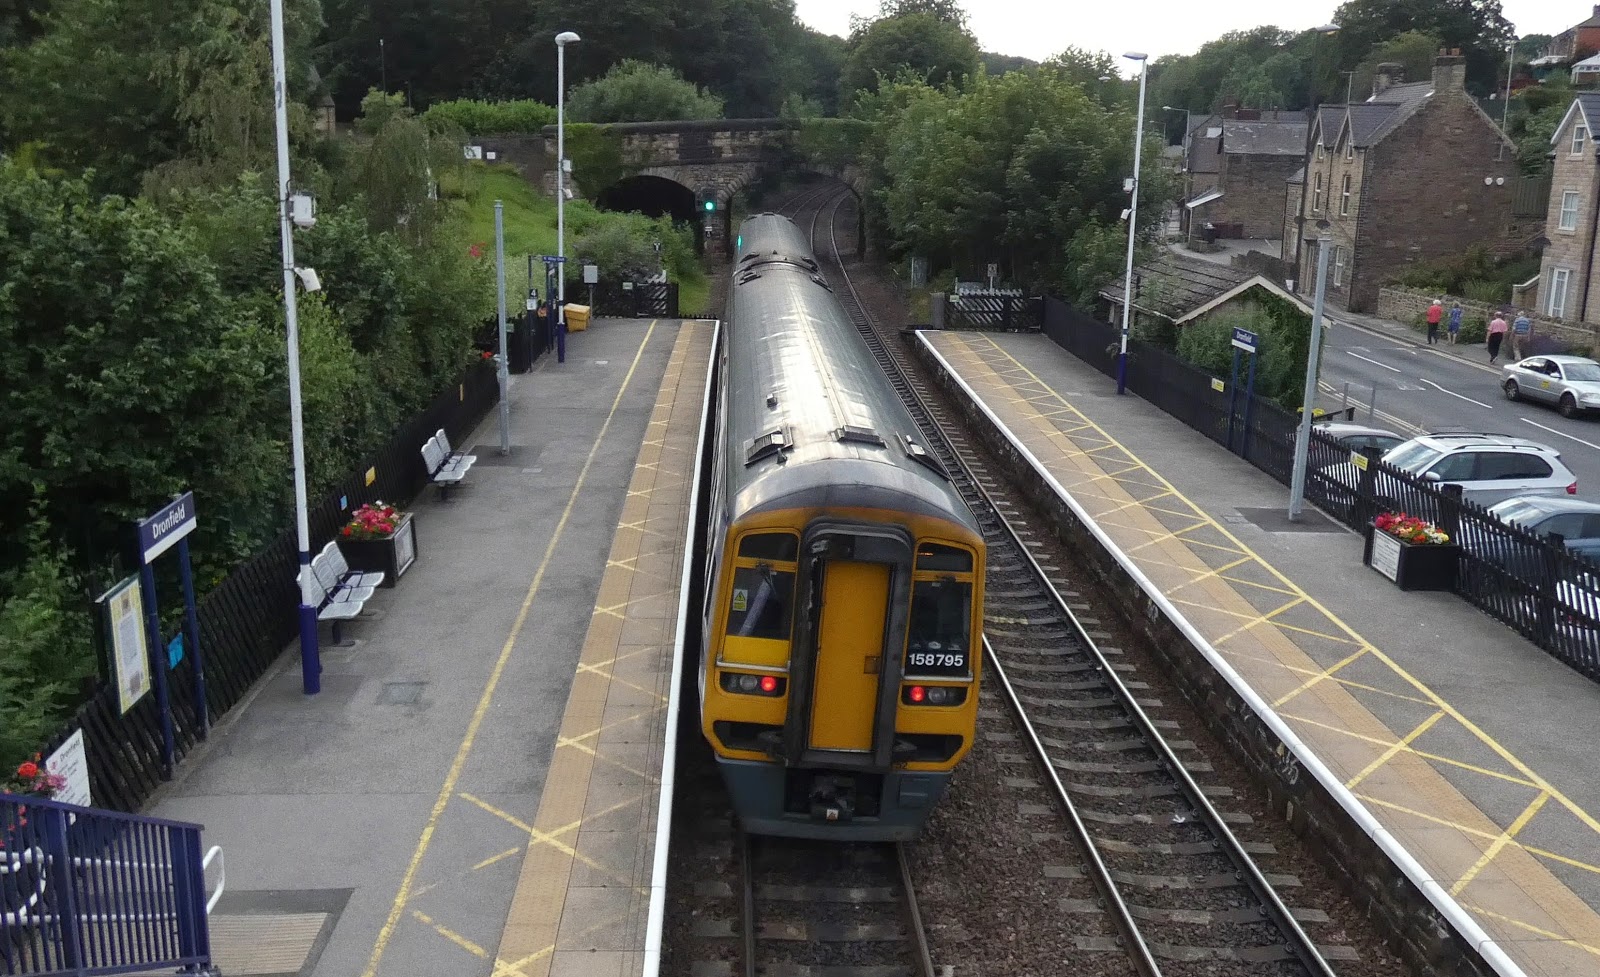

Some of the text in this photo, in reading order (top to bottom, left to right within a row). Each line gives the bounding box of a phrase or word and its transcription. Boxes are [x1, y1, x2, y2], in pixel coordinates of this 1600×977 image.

[530, 289, 537, 297] 4
[152, 503, 186, 540] Dronfield
[909, 653, 964, 667] 158795
